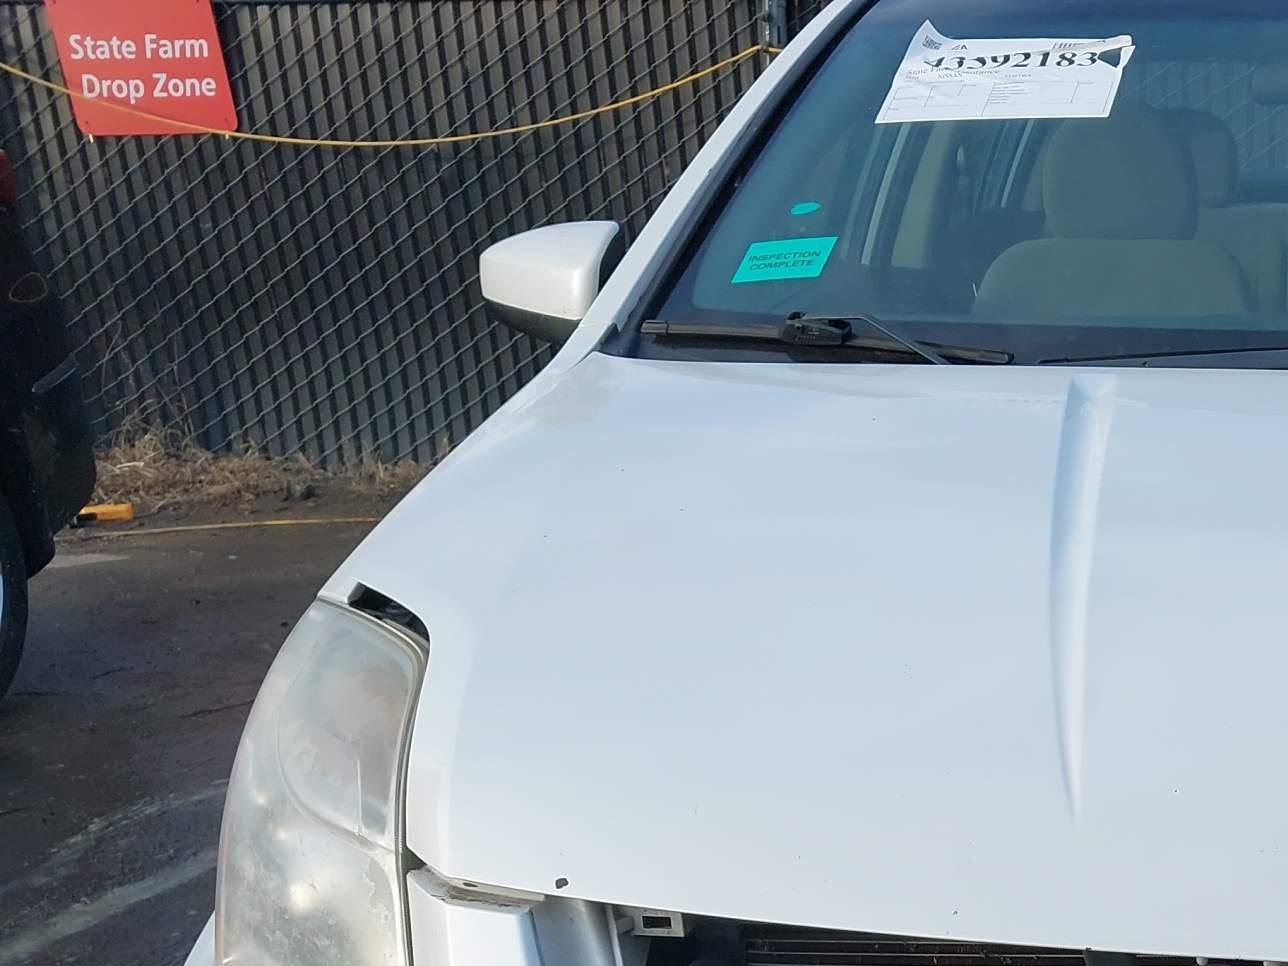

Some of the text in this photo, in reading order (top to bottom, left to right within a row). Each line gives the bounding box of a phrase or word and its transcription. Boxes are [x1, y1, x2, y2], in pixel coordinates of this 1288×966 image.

[69, 34, 209, 60] State Farm
[81, 73, 217, 104] Drop Zone
[748, 251, 821, 262] INSPECTION
[749, 260, 816, 271] COMPLETE
